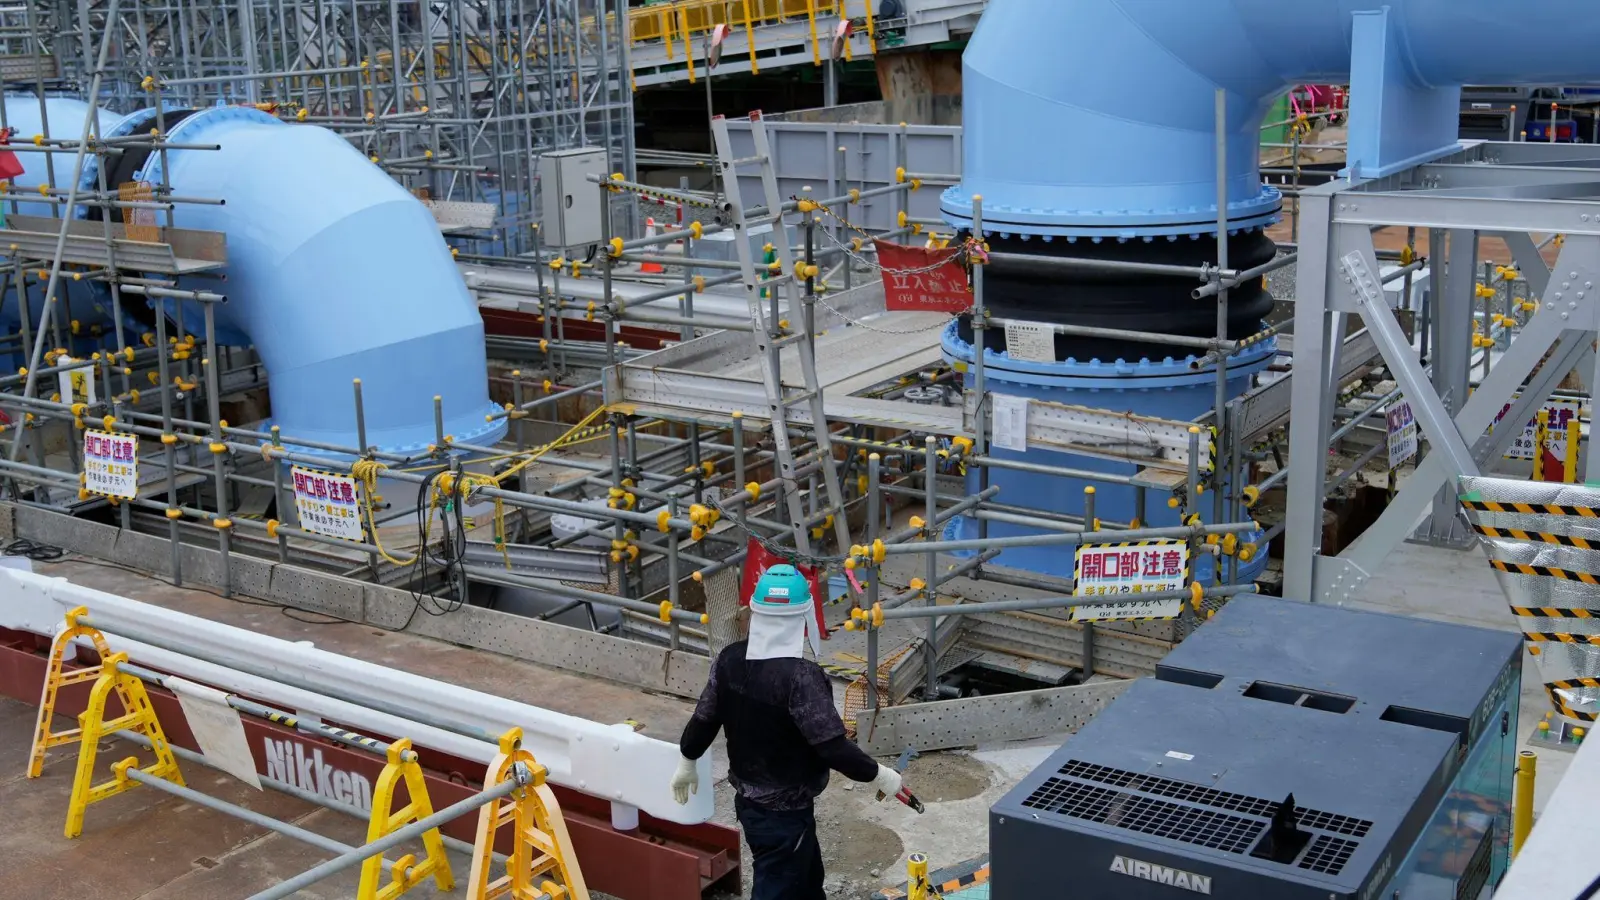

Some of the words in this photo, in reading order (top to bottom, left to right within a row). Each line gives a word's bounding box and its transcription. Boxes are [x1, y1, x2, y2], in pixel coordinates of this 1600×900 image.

[86, 435, 133, 462] 開口部注意
[294, 472, 355, 504] 開口部注意
[1081, 550, 1181, 581] 開口部注意
[264, 736, 372, 811] Nikken
[1109, 854, 1212, 895] AIRMAN
